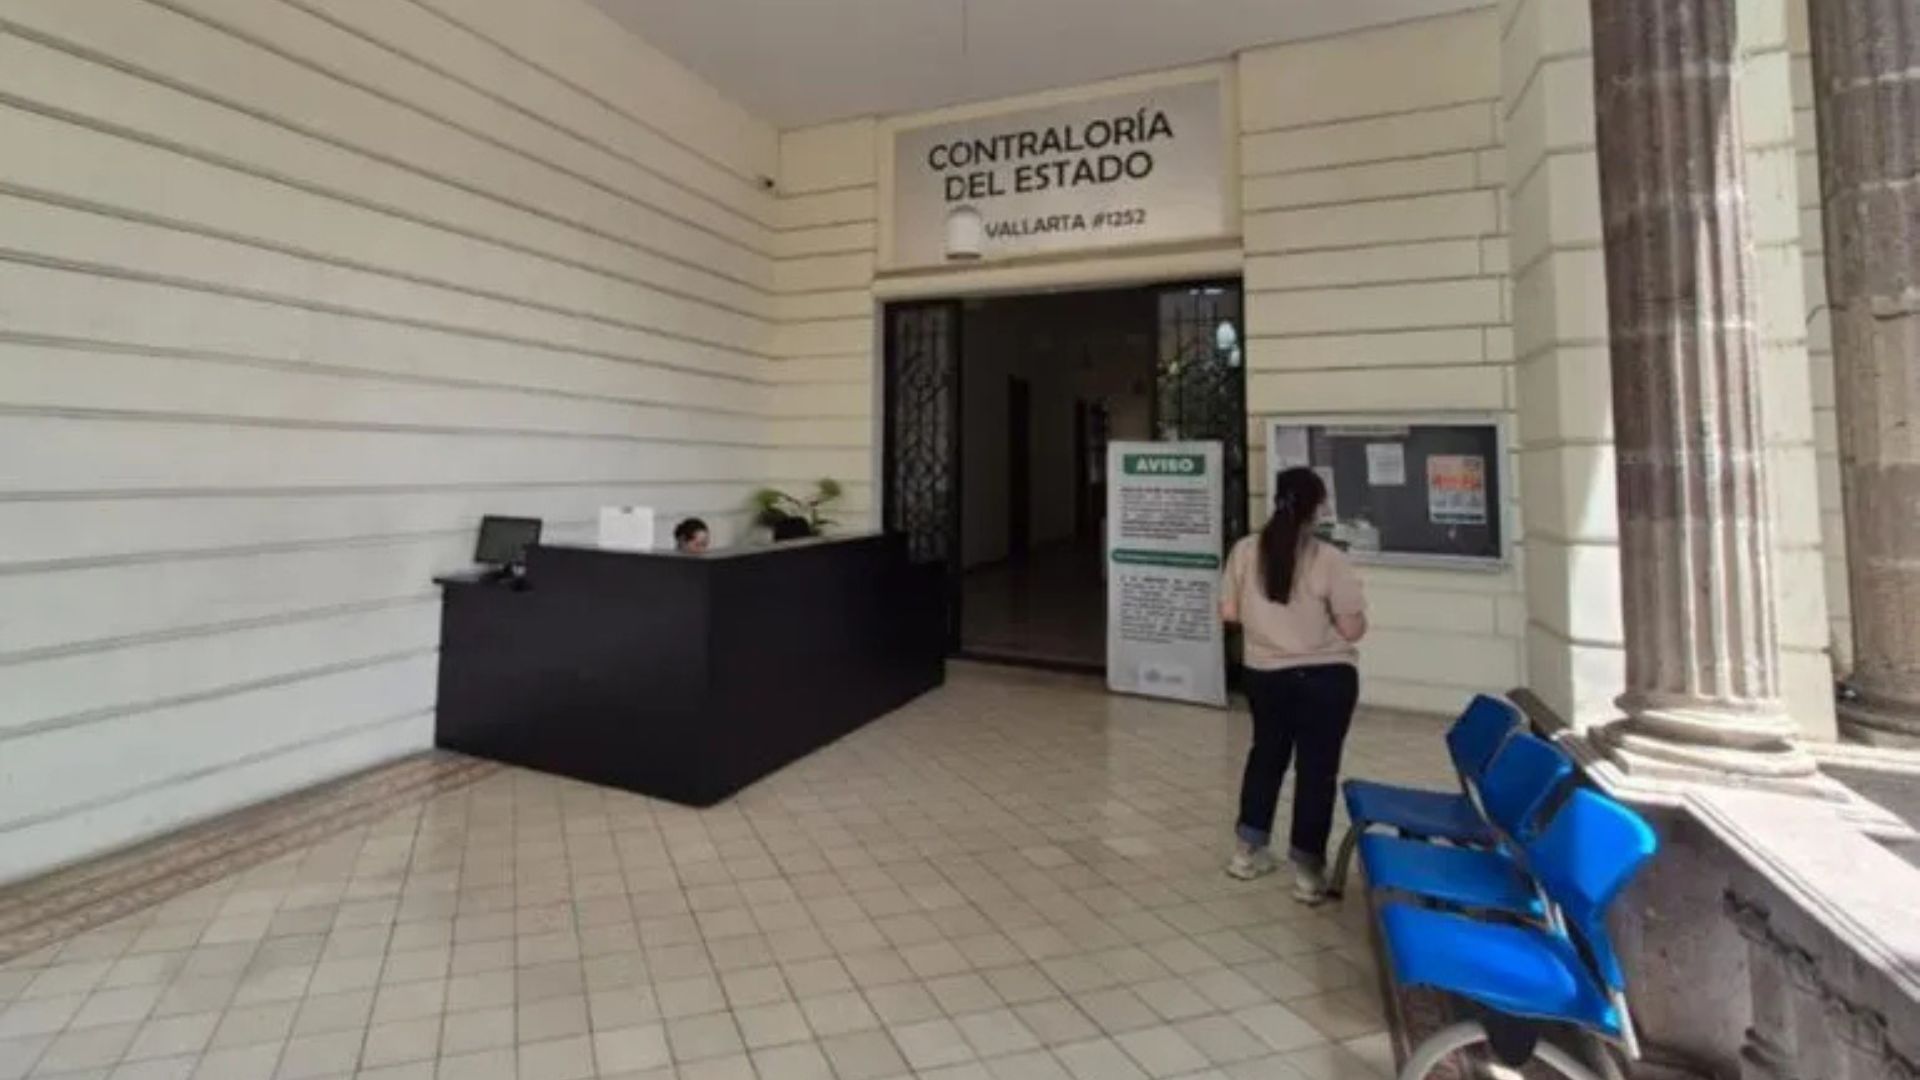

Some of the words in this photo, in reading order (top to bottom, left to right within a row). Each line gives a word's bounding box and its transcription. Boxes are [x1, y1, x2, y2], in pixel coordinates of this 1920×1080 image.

[928, 107, 1174, 171] CONTRALORÍA
[944, 172, 1005, 202] DEL
[1014, 150, 1154, 193] ESTADO
[984, 213, 1086, 239] VALLARTA
[1091, 208, 1147, 229] #1252
